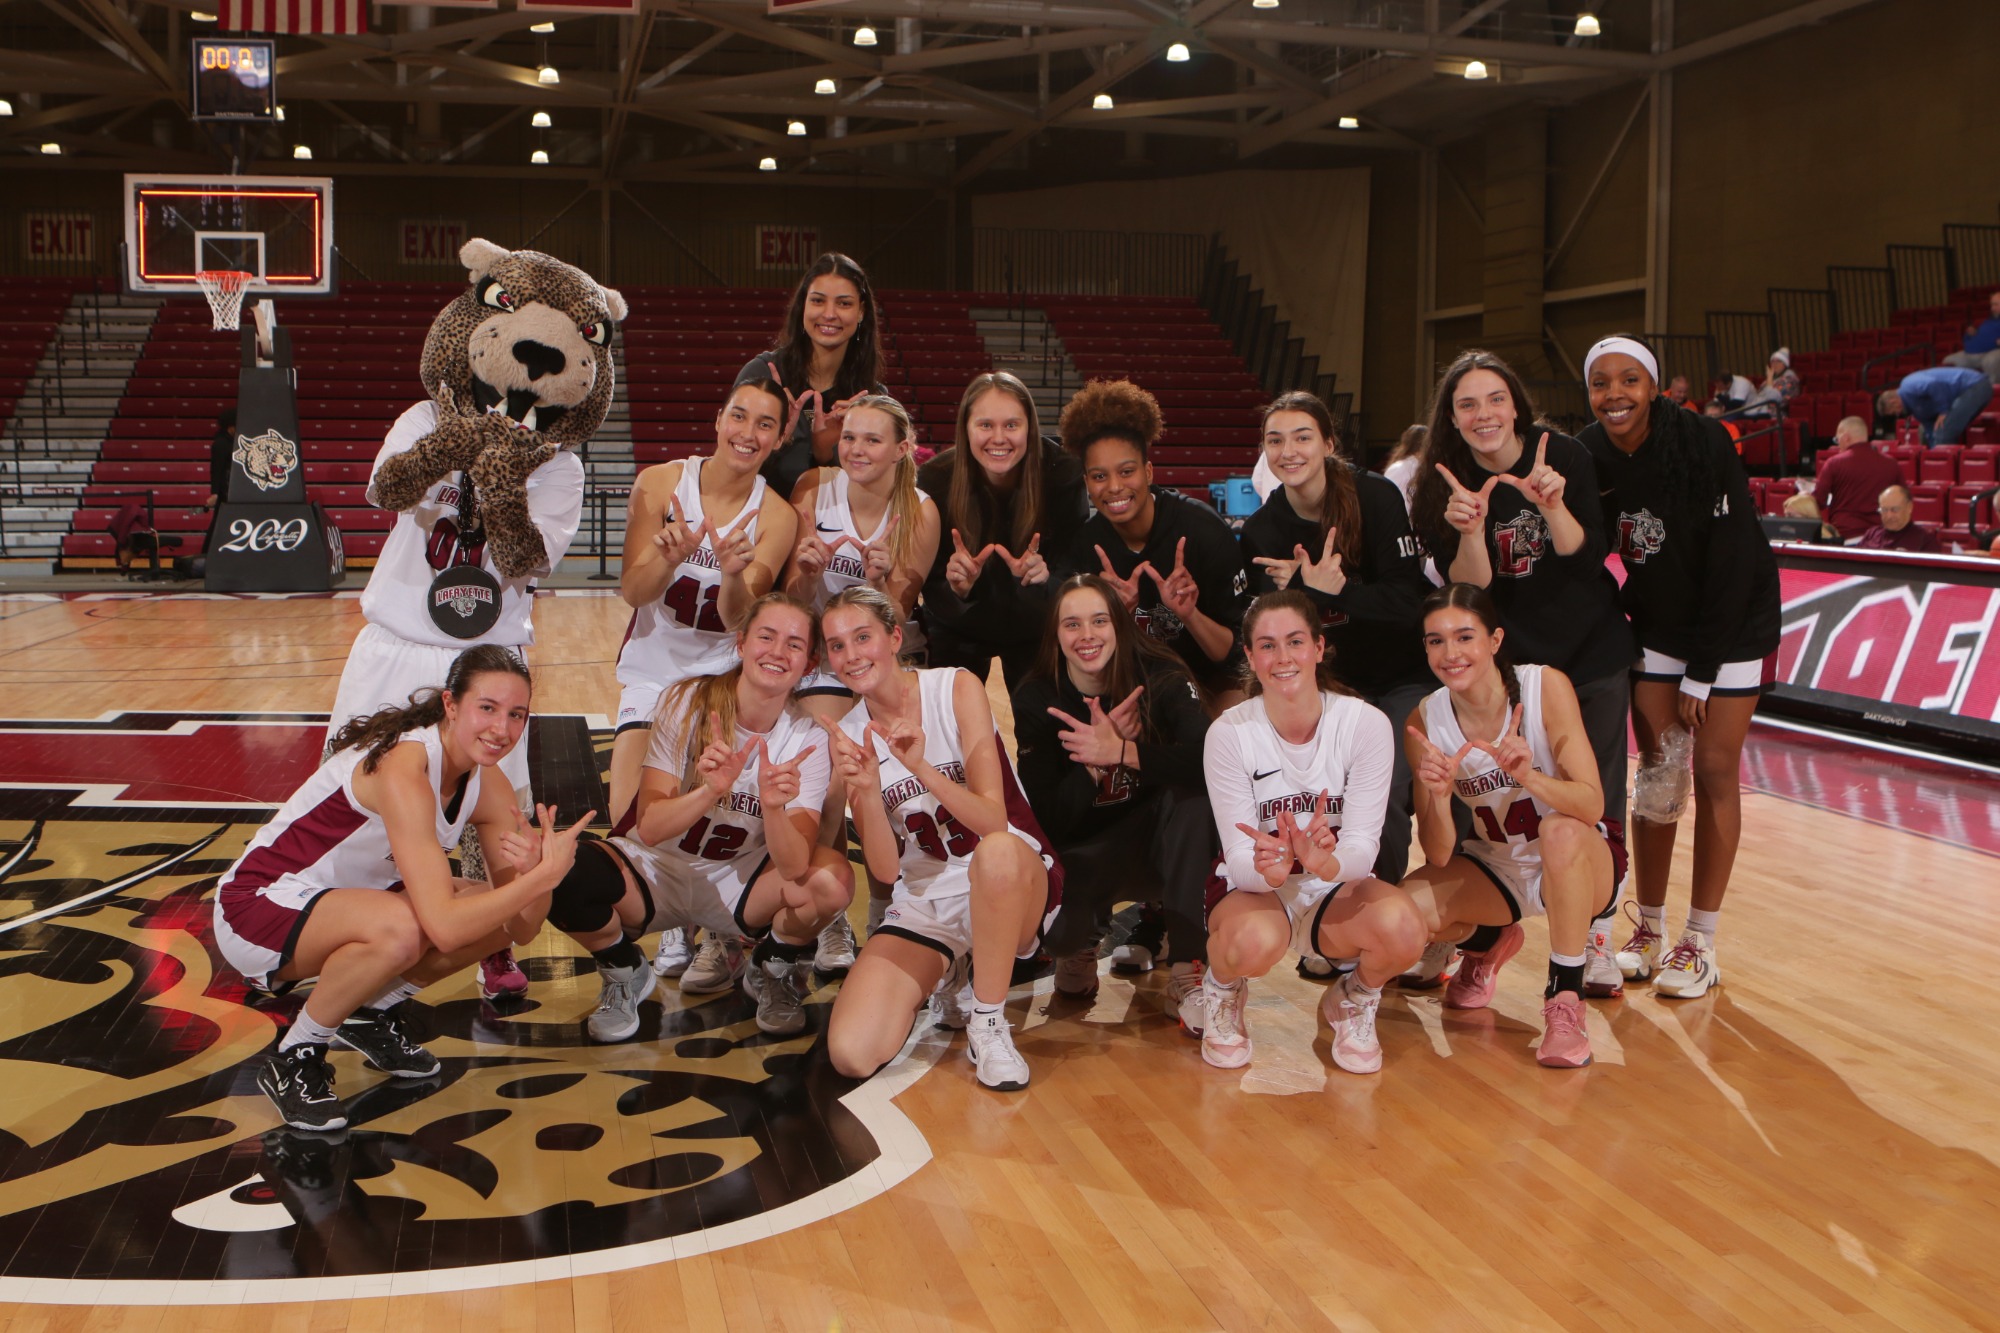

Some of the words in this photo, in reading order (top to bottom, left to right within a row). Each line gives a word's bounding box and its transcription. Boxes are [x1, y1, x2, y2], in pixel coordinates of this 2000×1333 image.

[30, 219, 92, 254] EXIT
[404, 224, 462, 259] EXIT
[762, 231, 816, 265] EXIT
[218, 518, 308, 552] 200
[1397, 535, 1415, 557] 10
[436, 586, 492, 605] LAFAYETTE
[1233, 568, 1248, 596] 23
[904, 804, 981, 862] 33
[1474, 797, 1542, 844] 14
[678, 815, 749, 861] 12
